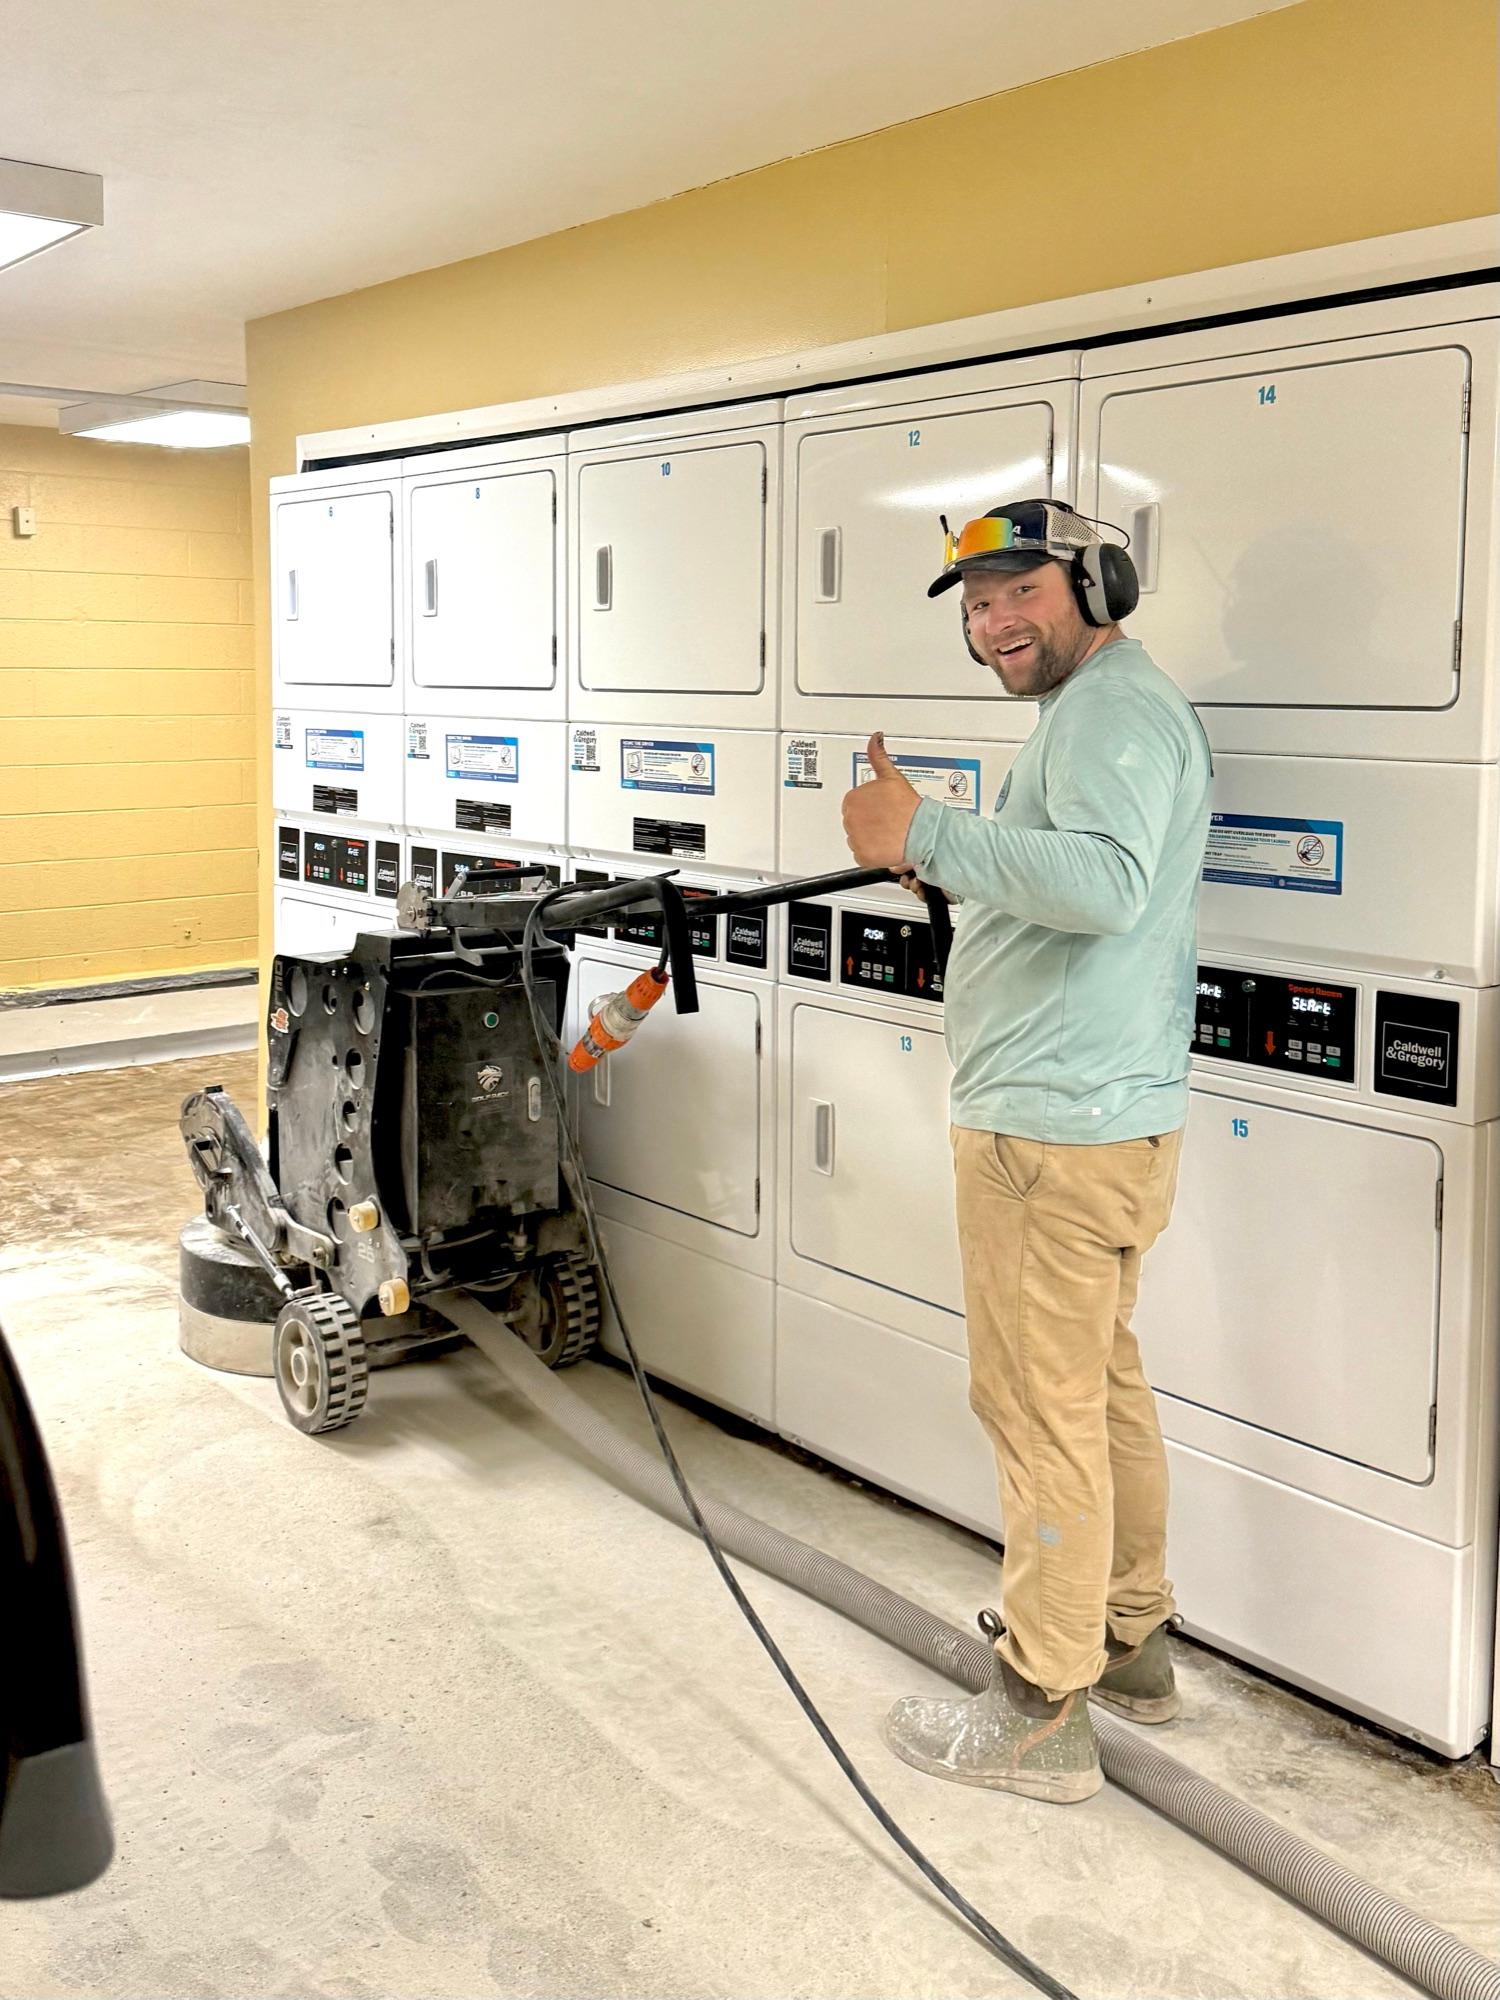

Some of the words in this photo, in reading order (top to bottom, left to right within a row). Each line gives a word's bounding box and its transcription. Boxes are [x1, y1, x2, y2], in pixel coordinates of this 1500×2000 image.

[1258, 384, 1277, 405] 14
[908, 430, 921, 447] 12
[661, 461, 671, 476] 10
[475, 487, 480, 500] 8
[328, 506, 333, 517] 6
[791, 740, 817, 748] Caldwell
[734, 926, 760, 938] Caldwell
[863, 928, 884, 941] PUSH
[731, 933, 762, 946] &Gregory
[796, 937, 824, 949] Caldwell
[793, 943, 825, 958] &Gregory
[1288, 984, 1314, 994] Speed
[1315, 986, 1343, 998] Queen
[900, 1035, 913, 1051] 13
[1393, 1040, 1442, 1058] Caldwell
[1386, 1046, 1446, 1071] &Gregory
[1231, 1118, 1249, 1137] 15
